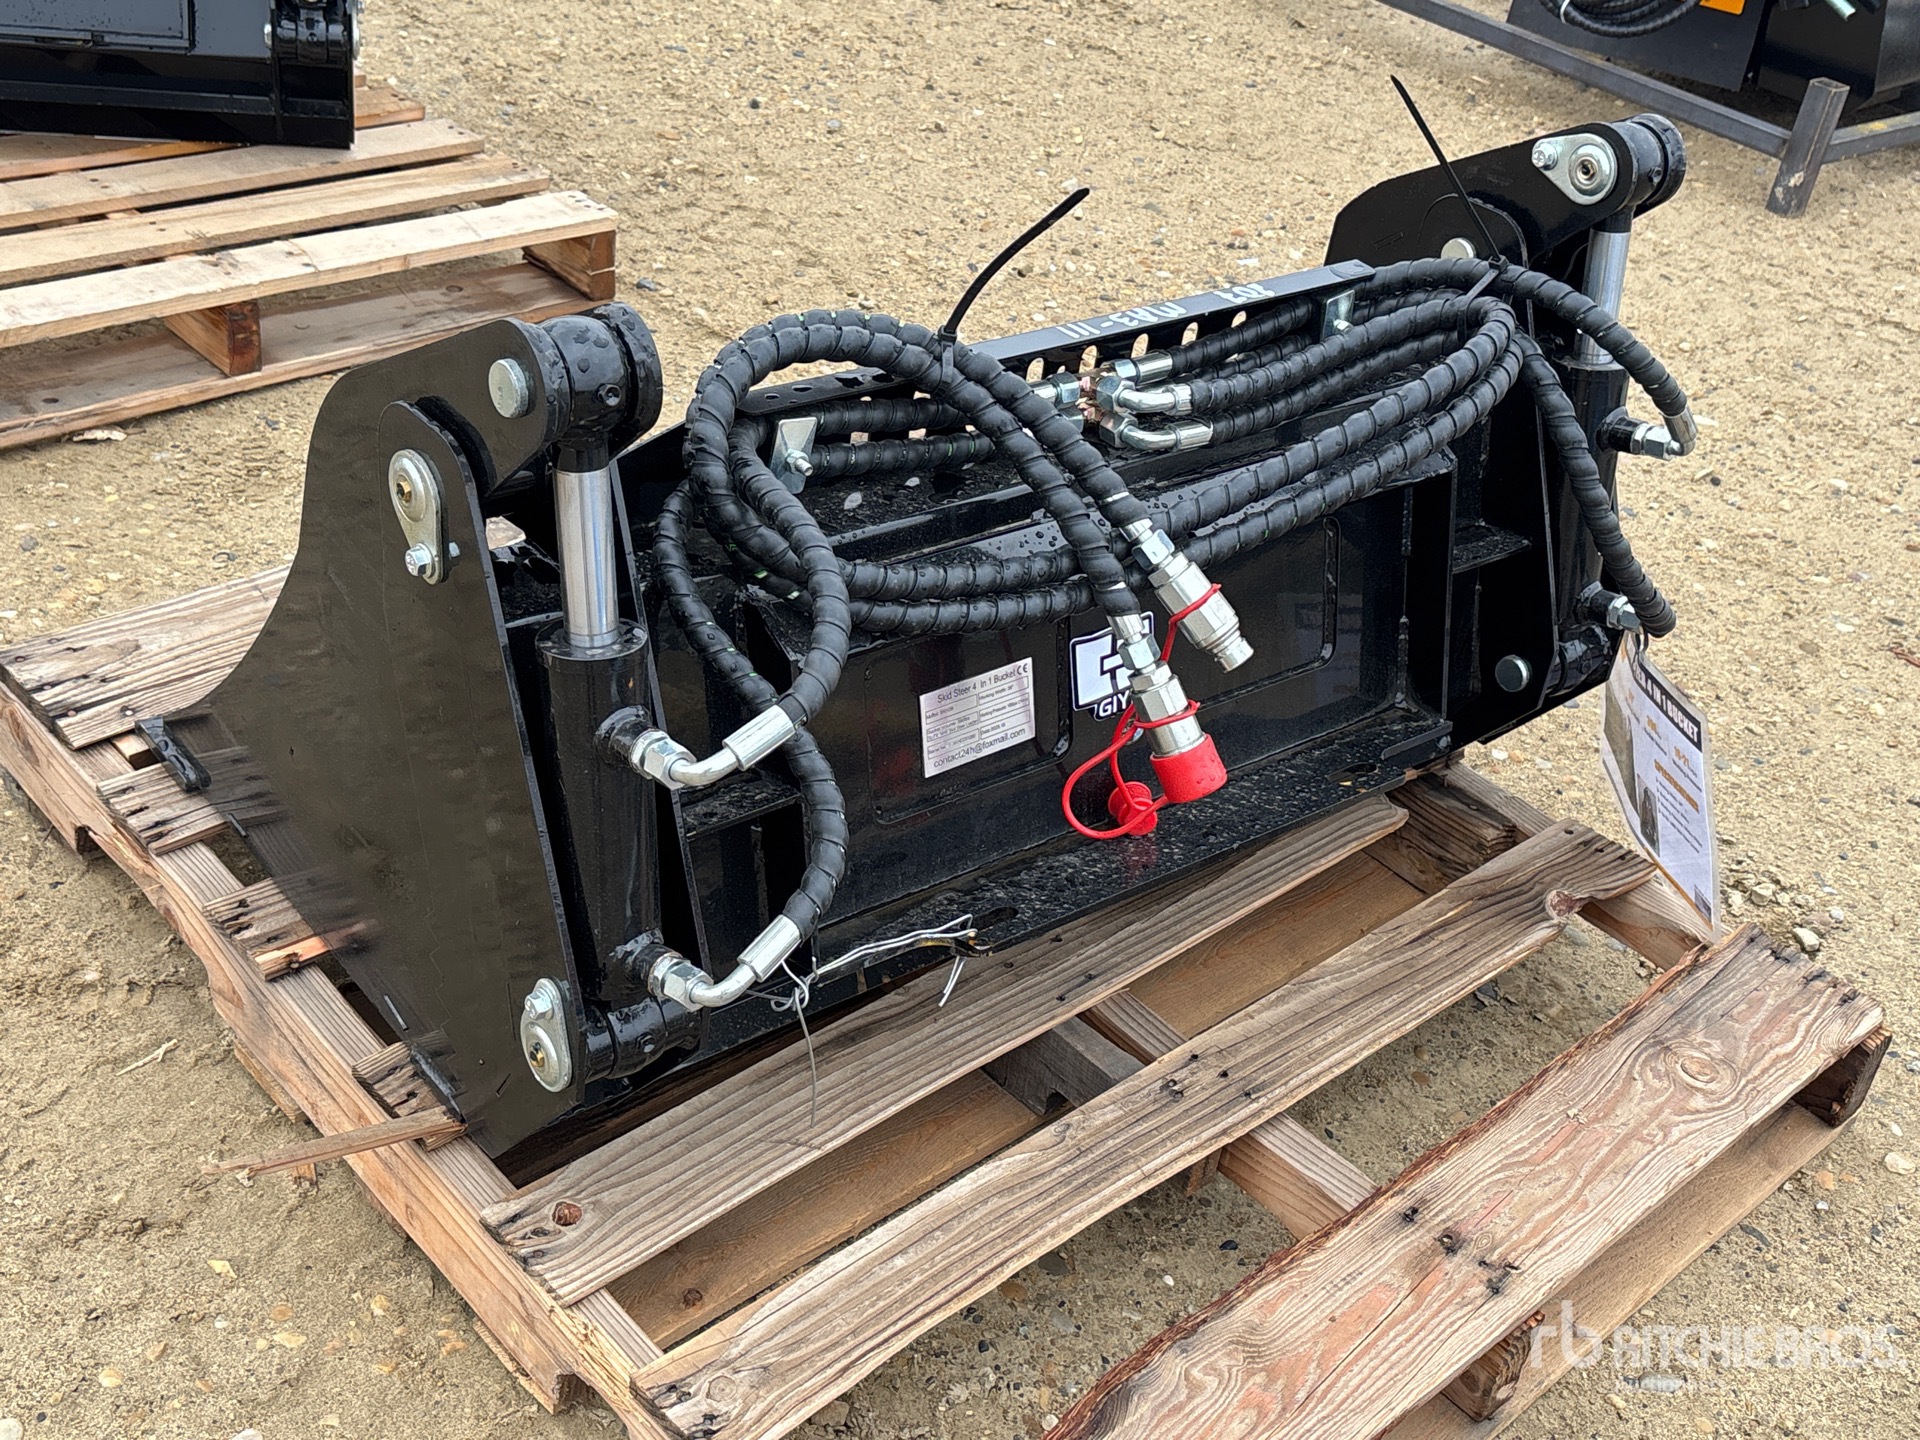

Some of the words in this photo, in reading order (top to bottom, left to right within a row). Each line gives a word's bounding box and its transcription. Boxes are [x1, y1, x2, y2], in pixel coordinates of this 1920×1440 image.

[937, 692, 952, 704] Skid
[953, 686, 972, 699] Steer
[994, 669, 1016, 684] Bucket
[1667, 699, 1698, 743] BUCKET
[933, 728, 1026, 769] contact24h@foxmail.com
